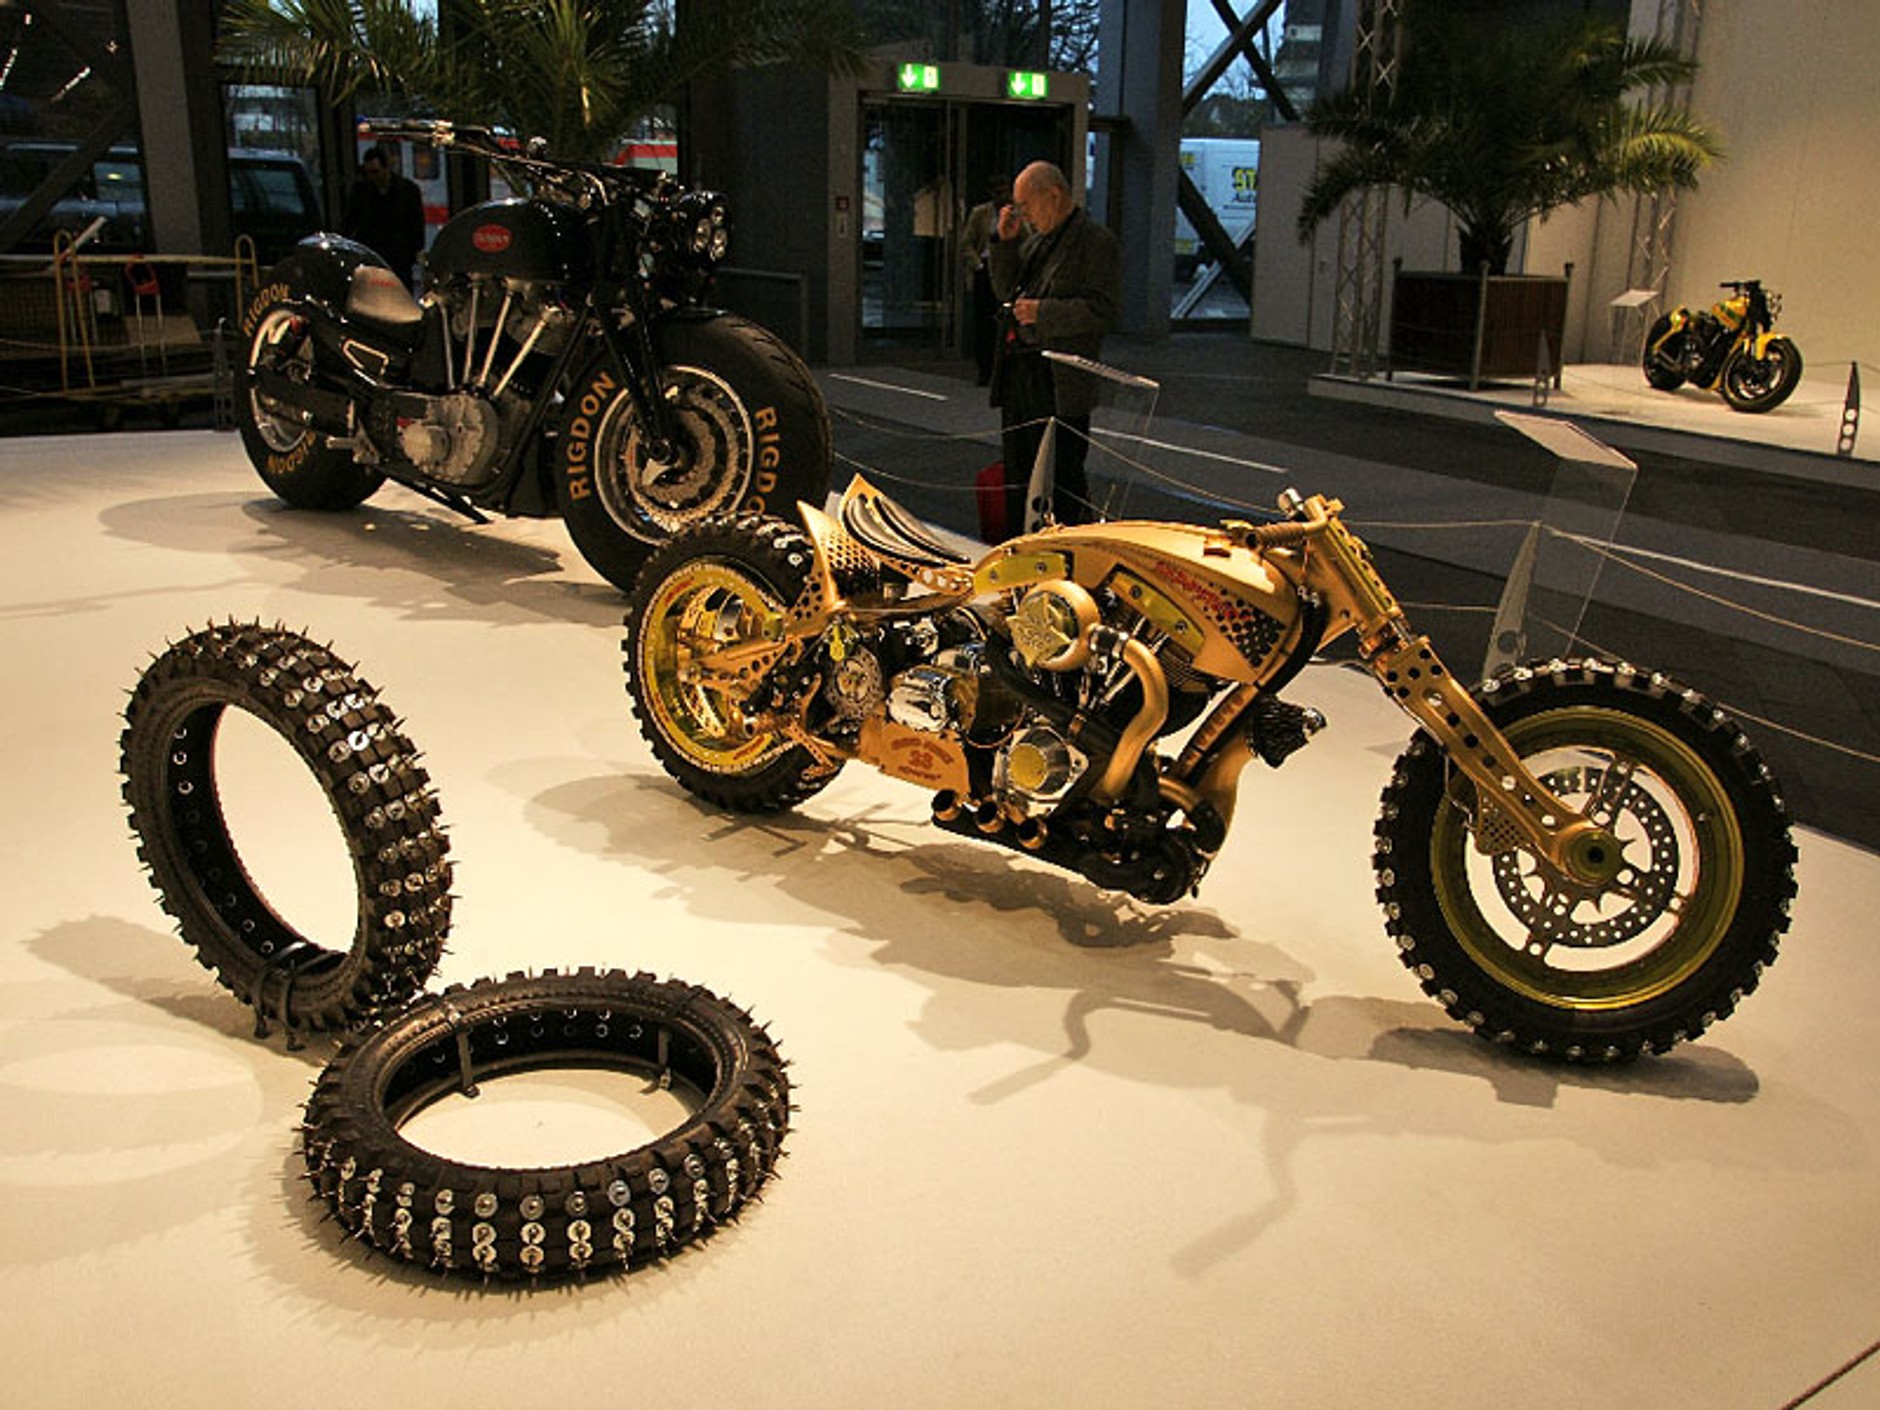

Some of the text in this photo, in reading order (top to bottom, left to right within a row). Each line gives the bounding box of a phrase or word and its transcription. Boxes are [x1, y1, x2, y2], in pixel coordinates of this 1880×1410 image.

[243, 284, 289, 337] RIGDON
[566, 372, 615, 499] RIGDON
[748, 406, 780, 514] RIGDO
